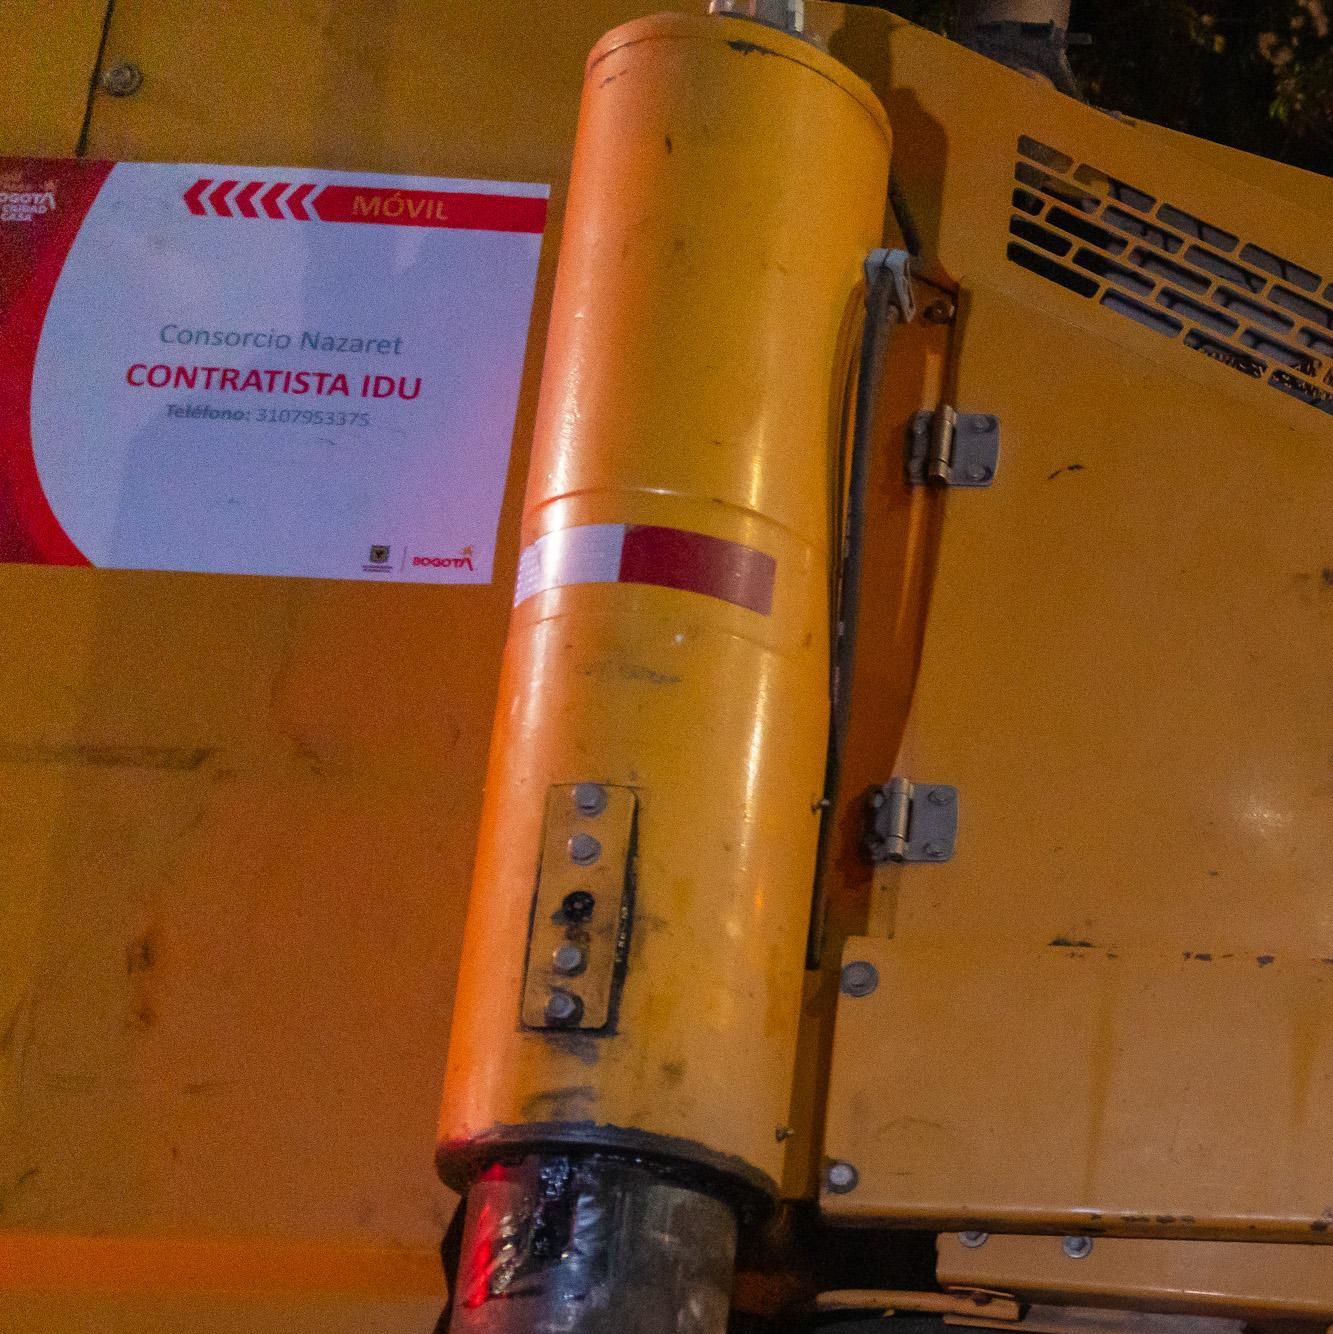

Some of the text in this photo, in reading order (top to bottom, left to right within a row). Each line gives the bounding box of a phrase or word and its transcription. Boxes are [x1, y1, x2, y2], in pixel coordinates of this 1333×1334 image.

[352, 191, 448, 220] MÓVIL
[159, 324, 404, 355] Consorcio Nazaret
[125, 363, 422, 400] CONTRATISTA IDU
[165, 404, 251, 422] Teléfono:
